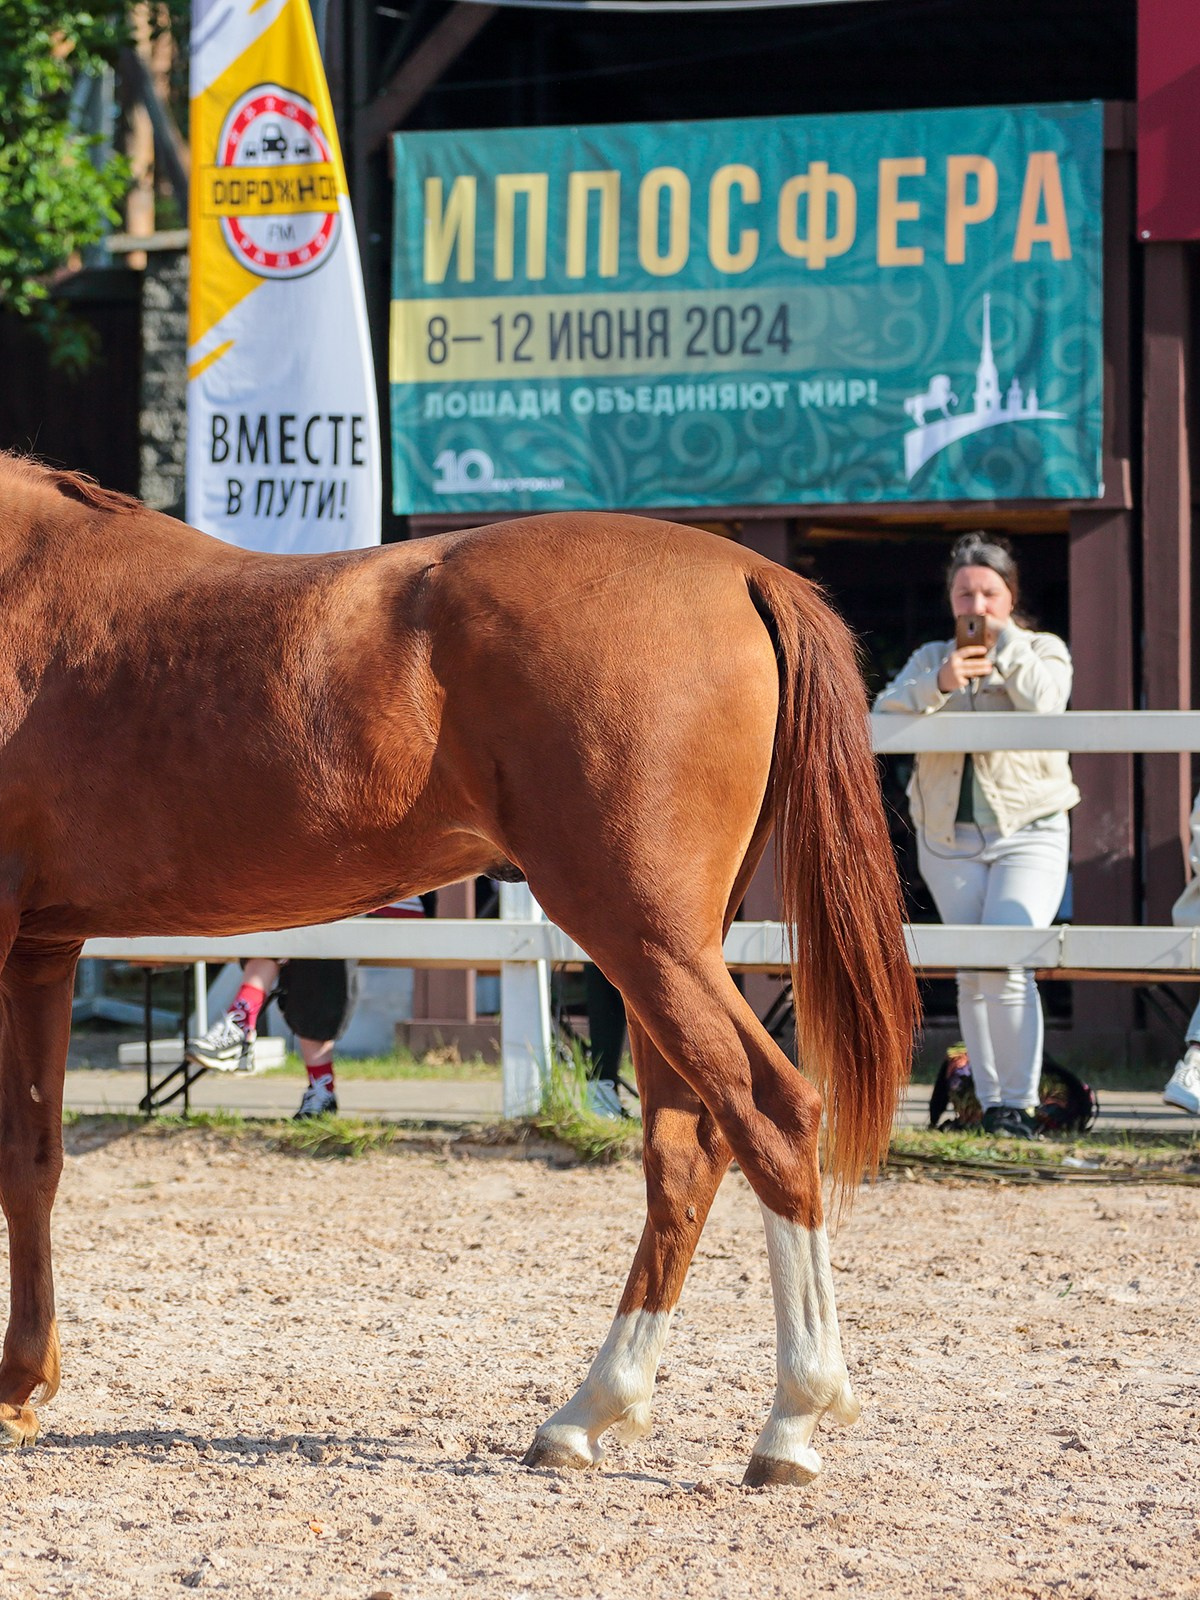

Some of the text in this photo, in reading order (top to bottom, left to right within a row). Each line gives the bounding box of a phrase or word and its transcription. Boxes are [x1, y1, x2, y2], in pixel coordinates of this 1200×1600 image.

[423, 151, 1072, 284] ИППОСФЕРА
[548, 307, 670, 361] ИЮНЯ
[685, 303, 793, 357] 2024
[424, 379, 879, 420] ЛОШАДИ ОБЪЕДИНЯЮТ МИР!
[211, 414, 365, 466] ВМЕСТЕ
[226, 478, 348, 520] В ПУТИ!
